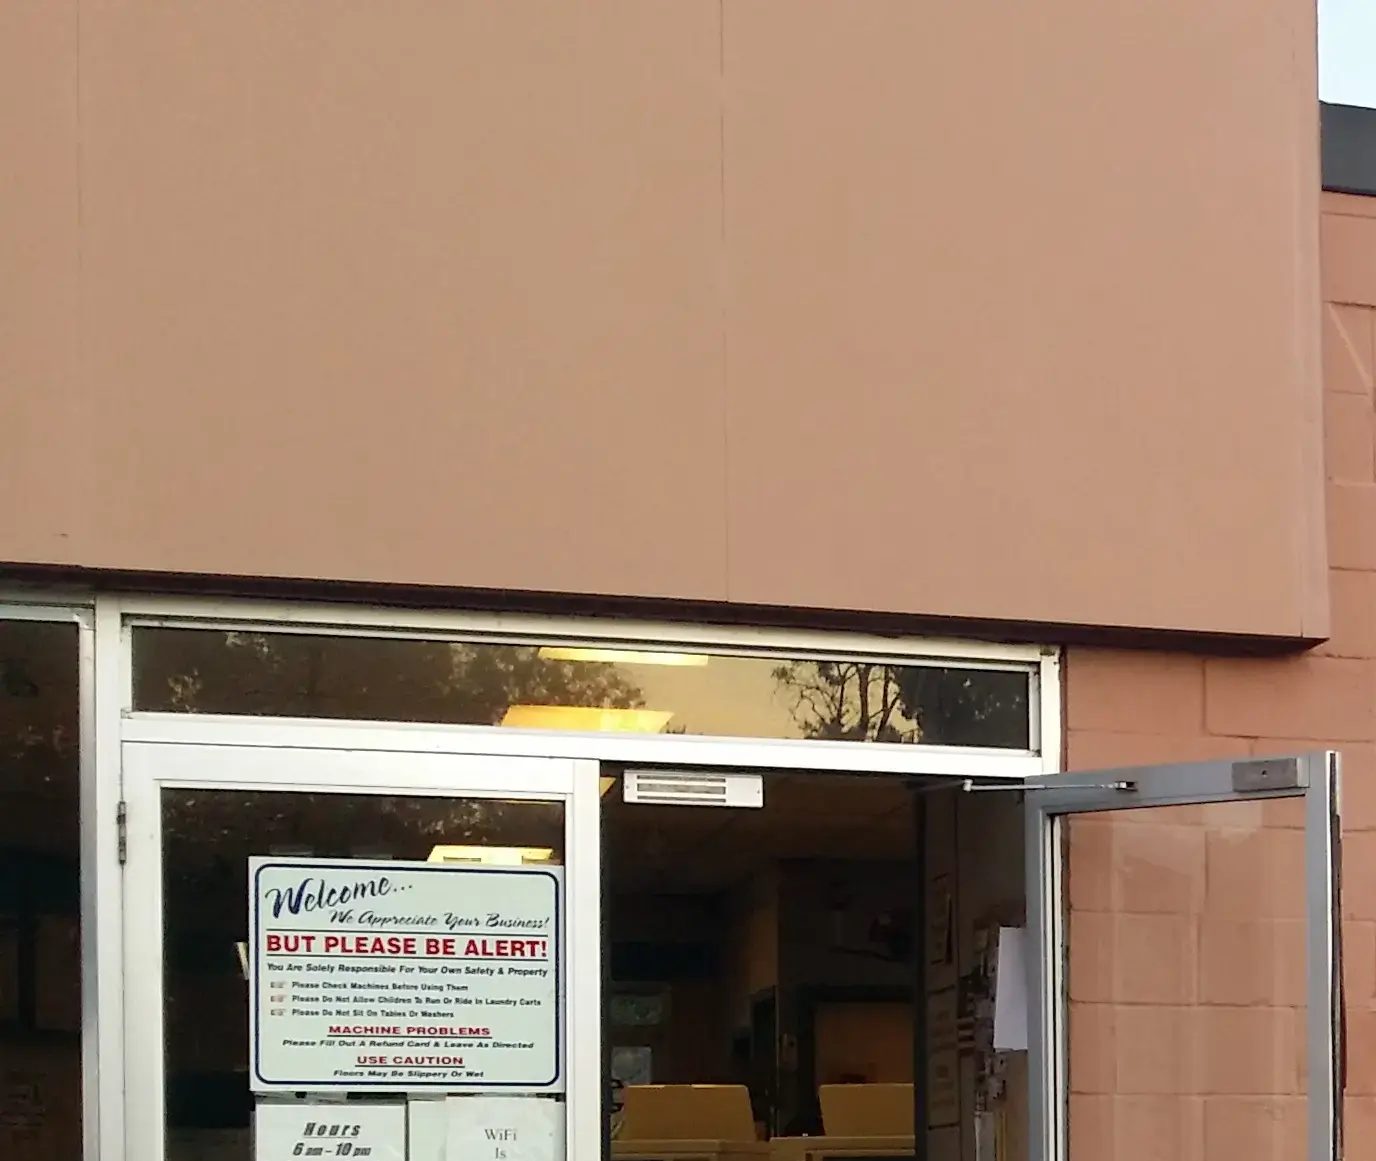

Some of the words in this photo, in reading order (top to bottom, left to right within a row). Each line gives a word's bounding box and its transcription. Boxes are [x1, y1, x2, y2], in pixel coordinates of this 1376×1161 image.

[329, 909, 354, 923] We
[358, 910, 437, 927] Appreciate
[444, 912, 480, 931] Your
[485, 913, 550, 929] Business!
[266, 935, 316, 951] BUT
[324, 936, 417, 955] PLEASE
[425, 938, 456, 955] BE
[464, 939, 547, 957] ALERT!
[268, 963, 283, 971] You
[286, 964, 303, 972] Are
[306, 964, 335, 973] Solely
[338, 965, 396, 973] Responsible
[418, 966, 438, 974] Your
[465, 967, 494, 976] Safety
[508, 968, 548, 977] Property
[350, 982, 389, 990] Machines
[421, 984, 443, 992] Using
[329, 1026, 401, 1034] MACHINE
[406, 1026, 490, 1036] PROBLEMS
[357, 1056, 387, 1064] USE
[392, 1056, 463, 1065] CAUTION
[303, 1122, 361, 1137] Hours
[484, 1128, 518, 1141] WiFi
[293, 1142, 304, 1156] 6
[305, 1147, 323, 1156] am
[336, 1142, 353, 1156] 10
[353, 1147, 371, 1157] pm
[495, 1147, 507, 1159] Is
